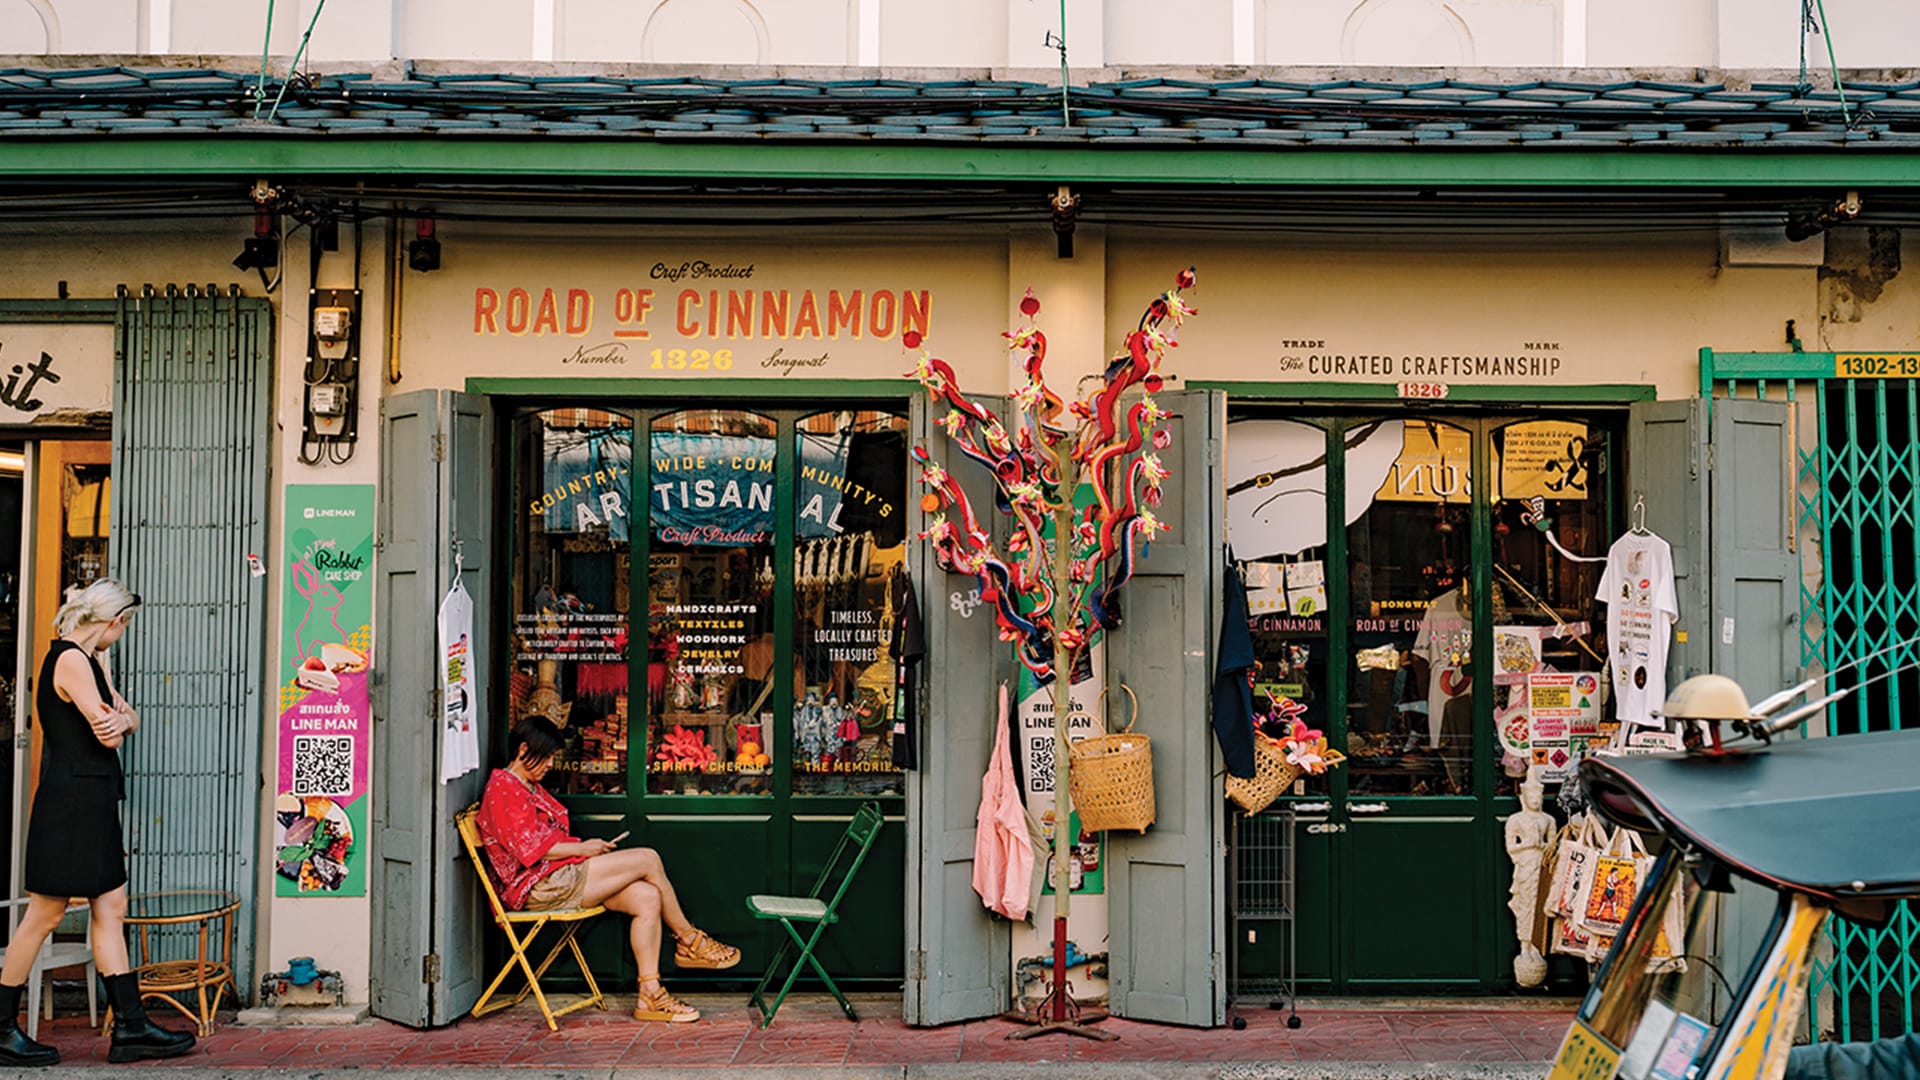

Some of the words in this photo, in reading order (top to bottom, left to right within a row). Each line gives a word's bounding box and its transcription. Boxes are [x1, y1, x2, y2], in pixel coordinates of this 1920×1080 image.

[649, 262, 690, 283] Craft
[689, 260, 755, 281] Product
[473, 287, 595, 338] ROAD
[614, 287, 655, 325] OF
[676, 288, 932, 341] CINNAMON
[1282, 340, 1325, 349] TRADE
[563, 341, 630, 365] Number
[649, 348, 733, 371] 1326
[760, 347, 829, 377] Songwat
[1280, 355, 1304, 372] The
[1308, 355, 1393, 375] CURATED
[1402, 356, 1561, 376] CRAFTSMANSHIP
[1842, 357, 1920, 376] 1302-13
[1403, 383, 1442, 398] 1326
[656, 455, 706, 473] WIDE
[661, 525, 700, 543] Craft
[700, 525, 765, 546] Product
[315, 549, 364, 571] Rabbit
[666, 605, 757, 614] HANDICRAFTS
[1380, 600, 1438, 609] SONGWAT
[678, 620, 744, 629] TEXTILES
[1263, 619, 1321, 631] CINNAMON
[1356, 620, 1386, 631] ROAD
[1389, 620, 1399, 629] OF
[676, 635, 746, 644] WOODWORK
[814, 630, 852, 643] LOCALLY
[682, 650, 740, 659] JEWELRY
[678, 665, 744, 674] CERAMICS
[291, 718, 323, 731] LINE
[324, 718, 358, 730] MAN
[1025, 717, 1055, 728] LINE
[653, 761, 694, 773] SPIRIT
[709, 761, 766, 773] CHERISH
[804, 761, 829, 773] THE
